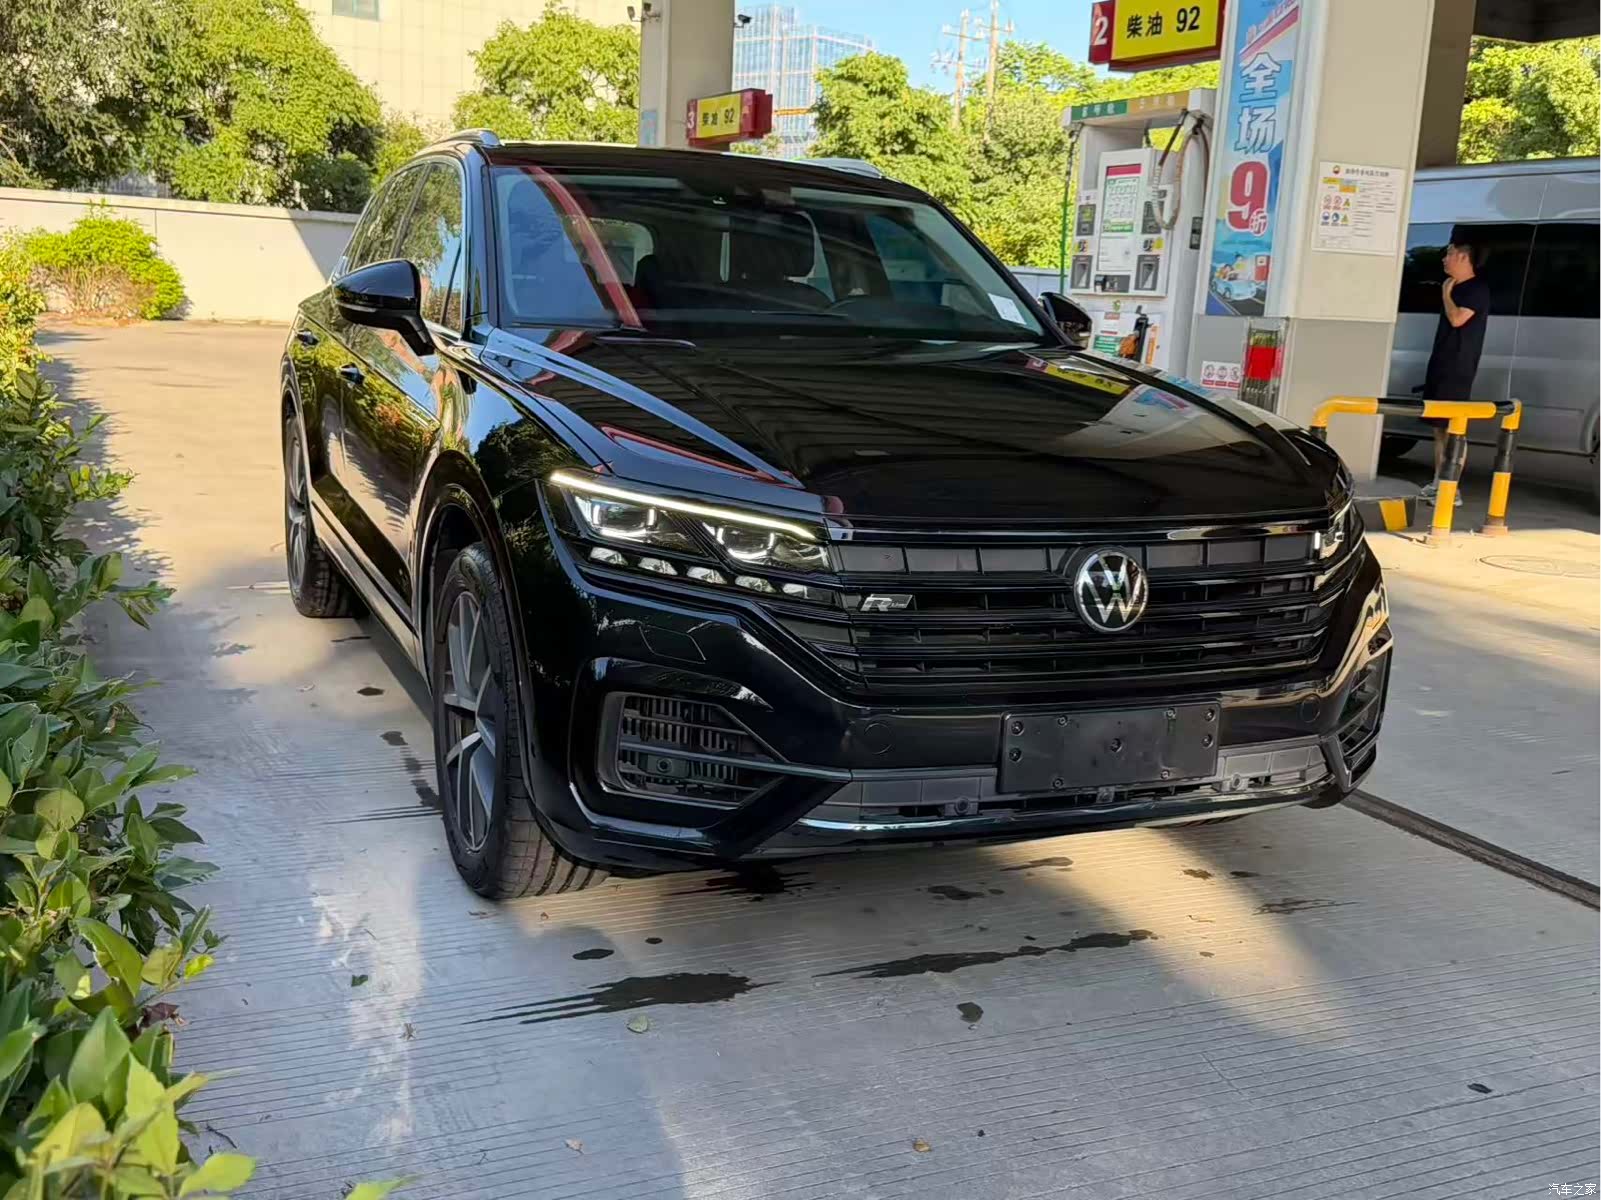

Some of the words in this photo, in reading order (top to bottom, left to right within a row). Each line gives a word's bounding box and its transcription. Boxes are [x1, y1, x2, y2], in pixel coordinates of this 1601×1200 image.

[1093, 15, 1109, 46] 2
[1126, 11, 1163, 39] 柴油
[1176, 5, 1201, 33] 92
[687, 111, 696, 129] 3
[724, 107, 735, 125] 92
